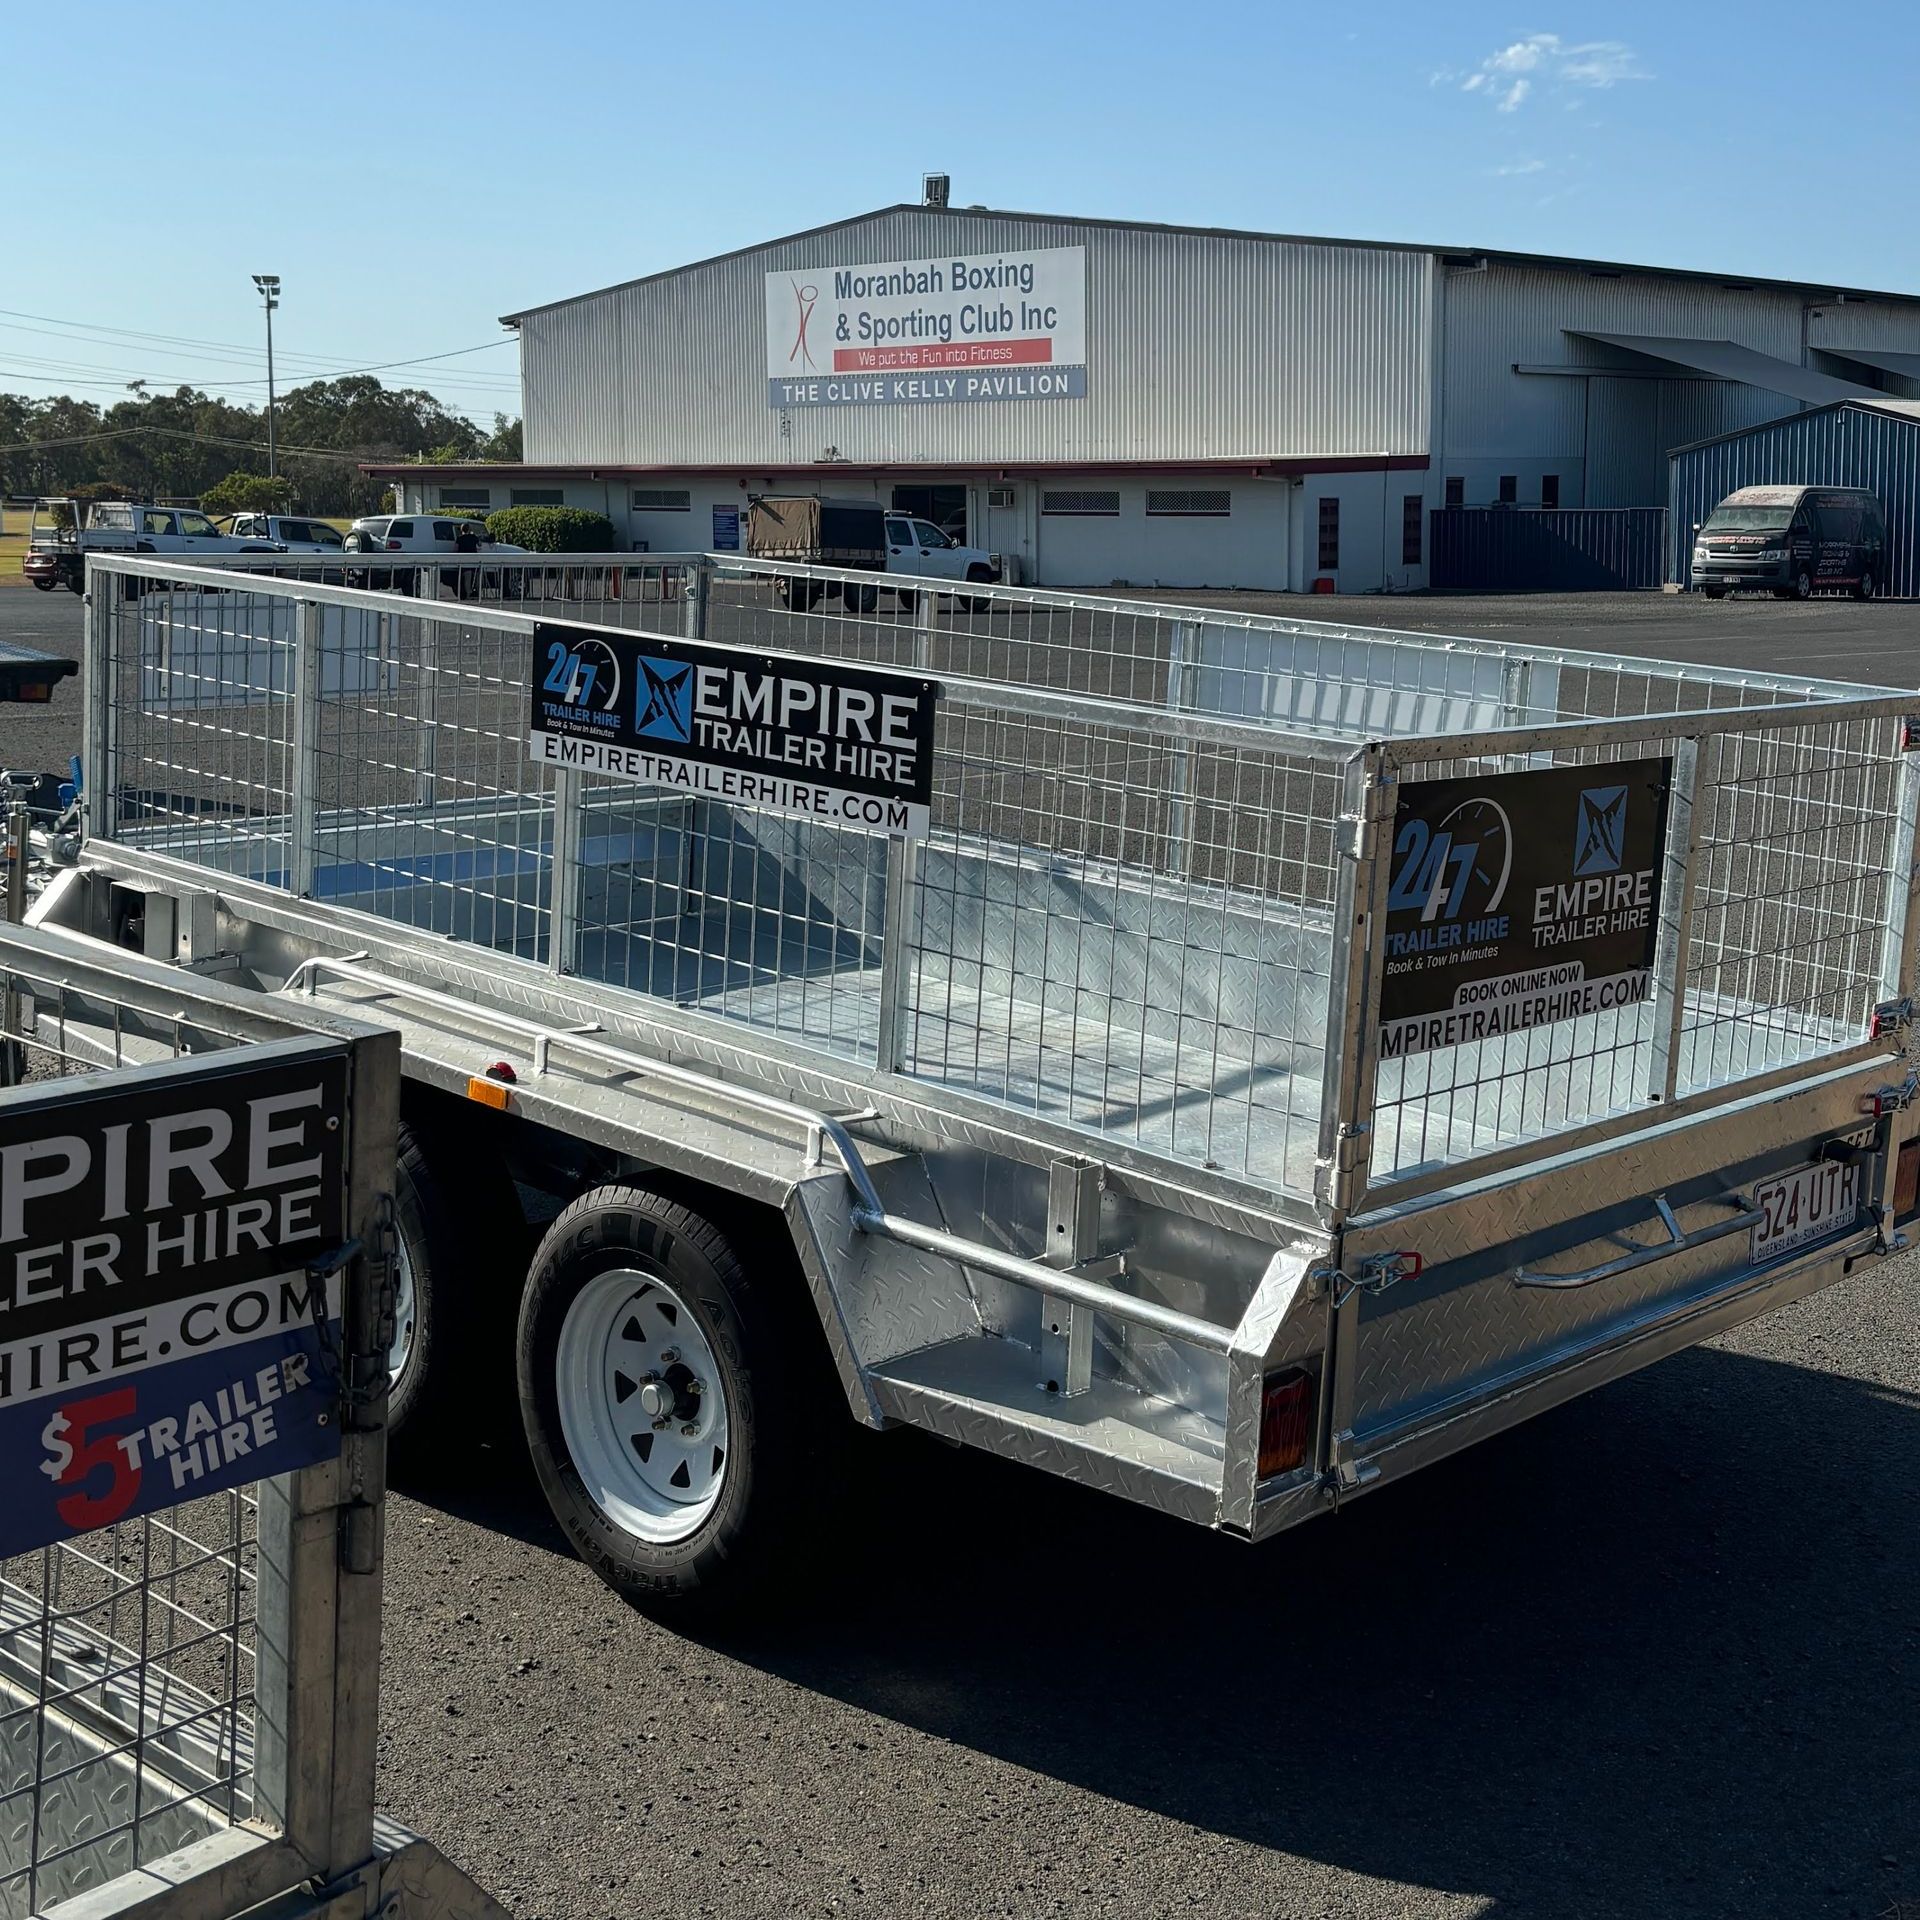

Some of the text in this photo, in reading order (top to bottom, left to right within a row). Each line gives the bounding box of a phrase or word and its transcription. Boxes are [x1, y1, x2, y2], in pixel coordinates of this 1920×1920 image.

[835, 259, 1034, 300] Moranbah Boxing
[835, 301, 1058, 346] & Sporting Club Inc
[859, 346, 1013, 369] We put the Fun into Fitness
[783, 374, 1069, 402] THE CLIVE KELLY PAVILION
[542, 702, 621, 728] TRAILER HIRE
[547, 718, 561, 728] Book
[569, 722, 582, 732] Tow
[589, 726, 615, 738] Minutes
[694, 664, 919, 752] EMPIRE
[694, 718, 916, 787] TRAILER HIRE
[545, 736, 909, 830] EMPIRETRAILERHIRE.COM
[1532, 868, 1654, 924] EMPIRE
[1384, 915, 1510, 957] TRAILER HIRE
[1532, 907, 1650, 949] TRAILER HIRE
[1387, 946, 1499, 975] Book & Tow In Minutes
[1459, 965, 1580, 1006] BOOK ONLINE NOW
[0, 1183, 322, 1314] ER HIRE
[1757, 1234, 1798, 1258] QUEENSLAND
[1803, 1221, 1833, 1241] SUNSHINE
[1835, 1211, 1852, 1227] STATE
[117, 1352, 312, 1472] TRAILER
[168, 1405, 278, 1490] HIRE
